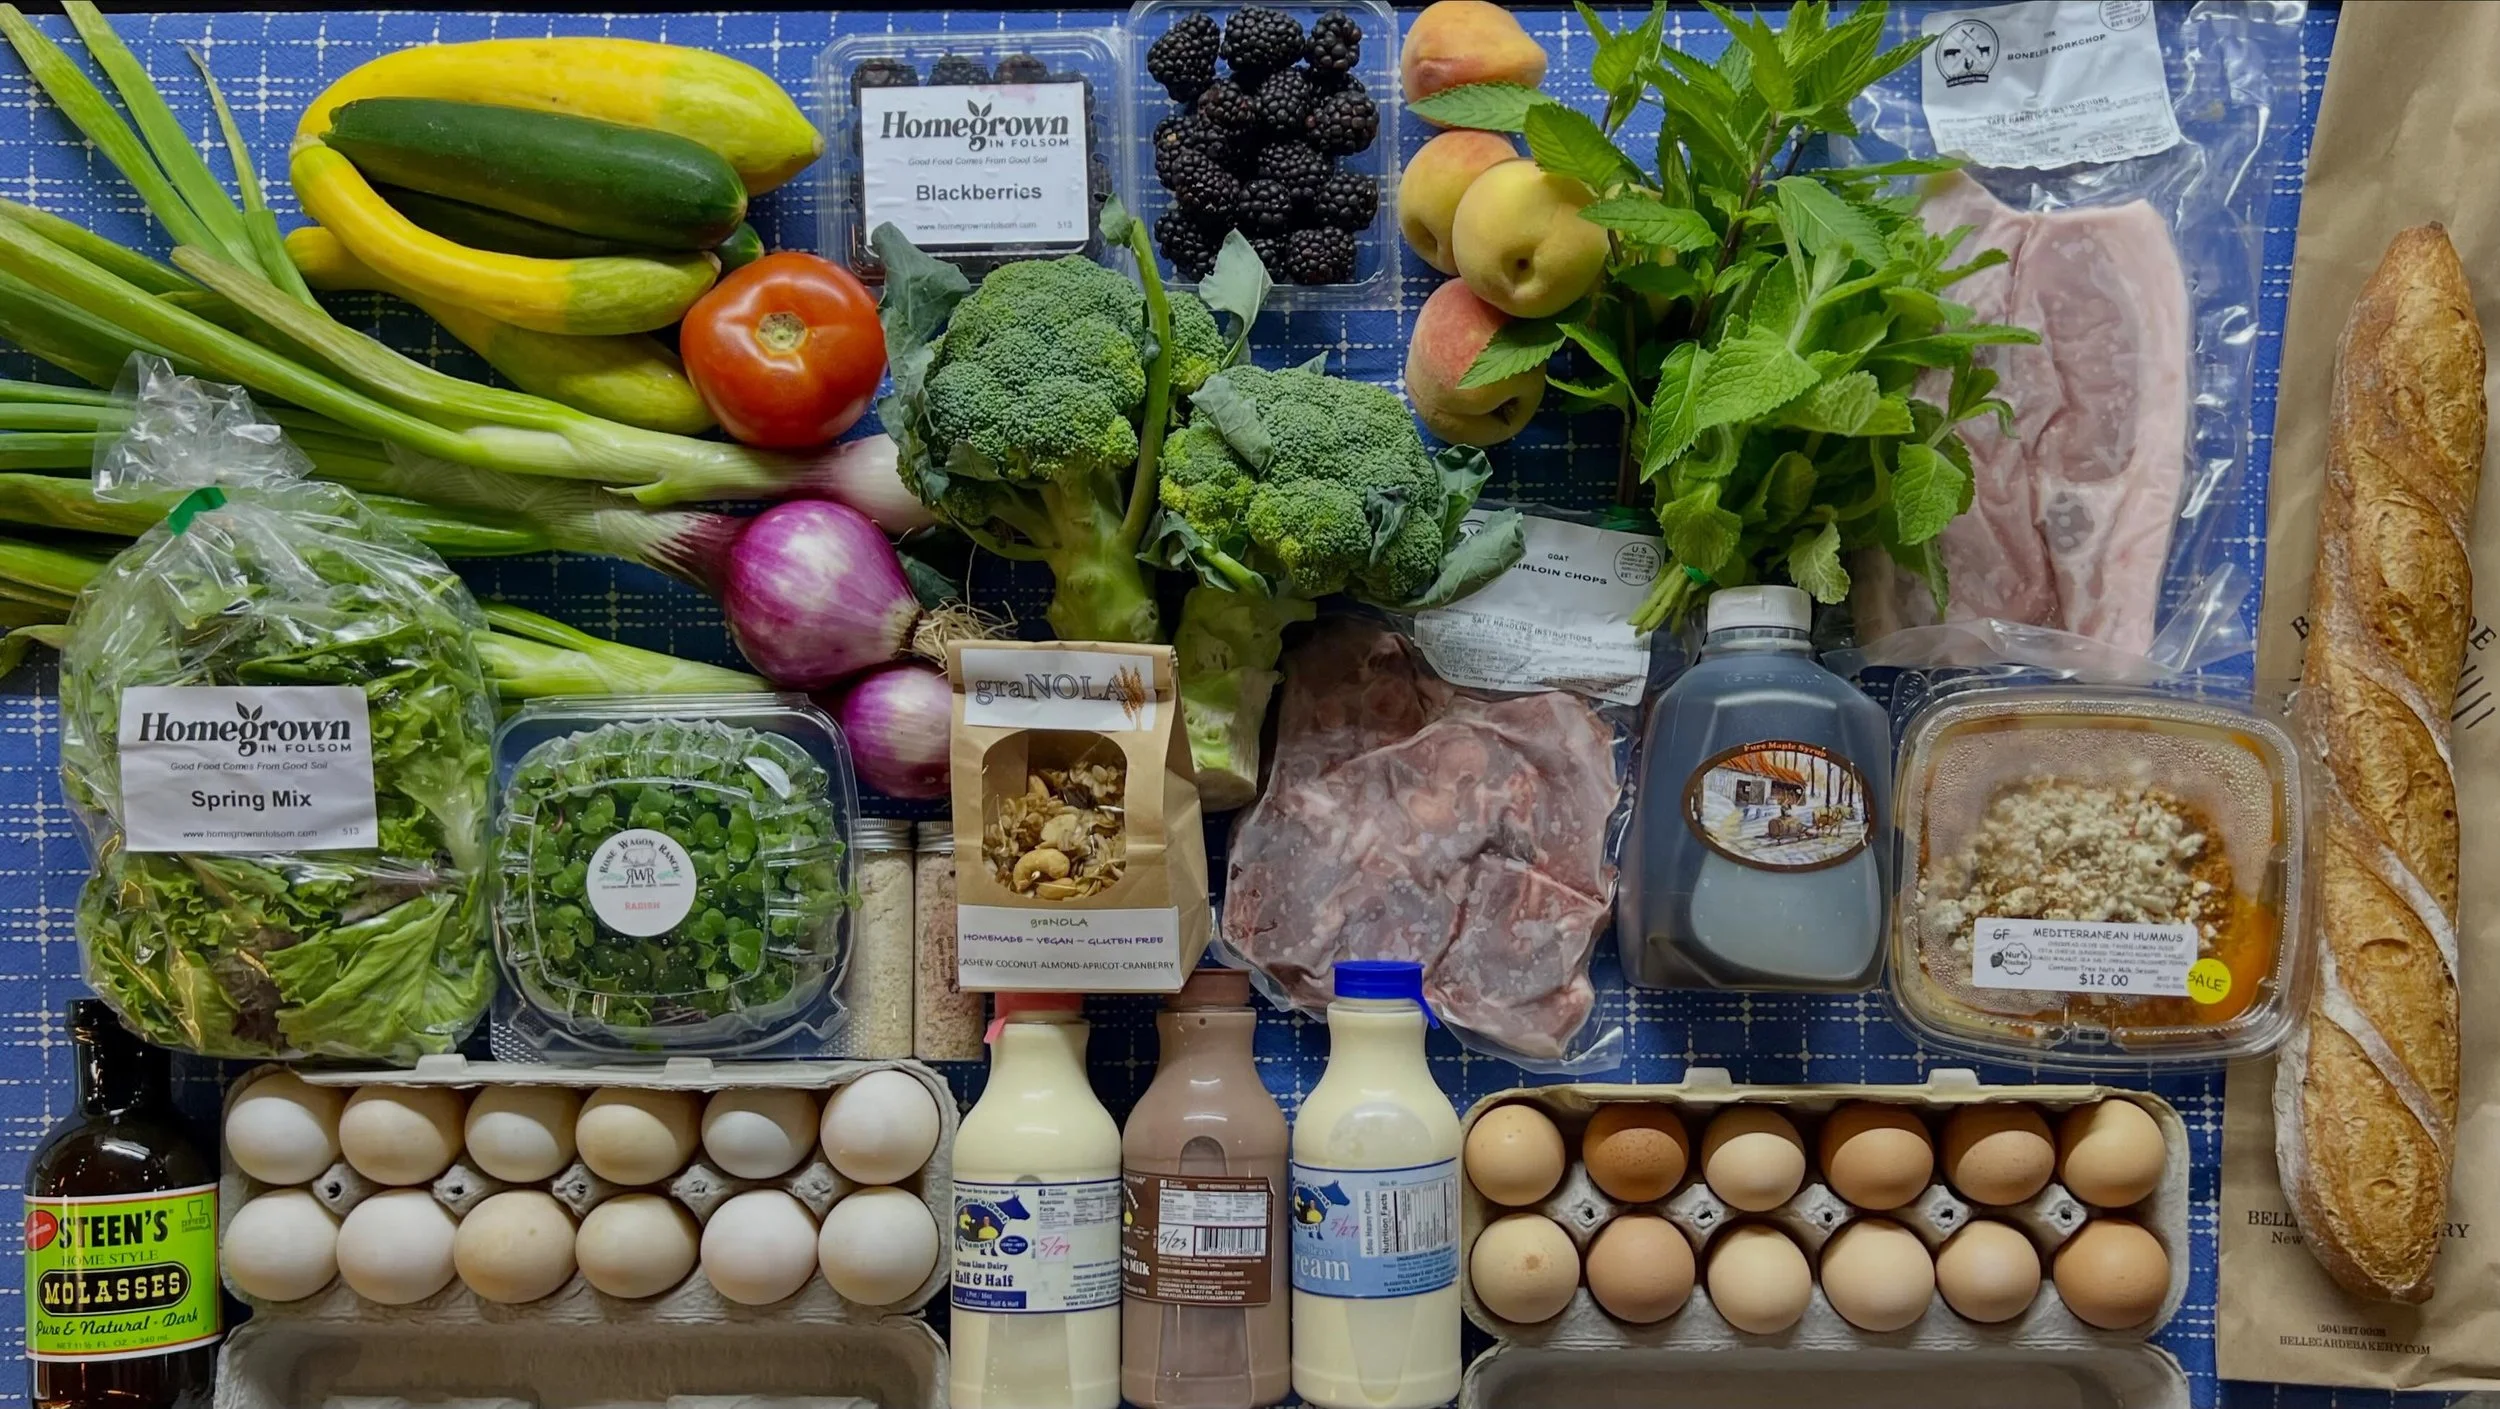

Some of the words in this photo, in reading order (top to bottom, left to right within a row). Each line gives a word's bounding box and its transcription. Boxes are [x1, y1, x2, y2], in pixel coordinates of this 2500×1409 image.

[2051, 34, 2105, 52] PORKCHOP
[880, 111, 1069, 151] Homegrown
[990, 139, 1003, 148] IN
[1012, 138, 1069, 147] FOLSOM
[908, 158, 930, 166] Good
[955, 157, 982, 165] Comes
[1009, 156, 1030, 164] Good
[916, 184, 1042, 200] Blackberries
[1548, 553, 1569, 562] GOAT
[1513, 562, 1560, 576] IRLOIN
[1565, 571, 1607, 584] CHOPS
[975, 674, 1128, 705] graNOLA
[139, 713, 351, 757] Homegrown
[261, 744, 276, 752] IN
[286, 743, 352, 752] FOLSOM
[1768, 742, 1796, 750] Maple
[1798, 744, 1827, 757] Syrup
[171, 762, 194, 770] Good
[197, 762, 220, 770] Food
[223, 762, 253, 770] Comes
[257, 762, 280, 770] From
[283, 762, 307, 770] Good
[311, 761, 328, 769] Soil
[191, 790, 264, 811] Spring
[273, 790, 312, 808] Mix
[343, 827, 359, 836] 513
[625, 901, 660, 910] RADISH
[1031, 918, 1088, 928] graNOLA
[964, 934, 1023, 943] HOMEMADE
[1036, 937, 1074, 946] VEGAN
[1088, 937, 1132, 945] GLUTEN
[1135, 936, 1163, 944] FREE
[1993, 928, 2011, 940] GF
[2033, 928, 2128, 941] MEDITERRANEAN
[2134, 931, 2184, 943] HUMMUS
[2005, 950, 2027, 959] Nur's
[2079, 973, 2128, 986] $12.00
[2188, 970, 2227, 992] SALE
[59, 1210, 168, 1248] STEEN'S
[1365, 1216, 1373, 1237] Heavy
[1381, 1217, 1390, 1254] Nutrition
[2272, 1231, 2304, 1244] New
[61, 1253, 104, 1266] HOME
[109, 1250, 158, 1265] STYLE
[987, 1262, 1008, 1271] Dairy
[1130, 1259, 1150, 1276] Milk
[1295, 1254, 1351, 1281] ream
[955, 1269, 971, 1284] Half
[973, 1273, 982, 1285] &
[985, 1274, 1014, 1287] Half
[44, 1272, 180, 1305] MOLASSES
[36, 1320, 60, 1336] Pure
[64, 1320, 75, 1335] &
[82, 1316, 150, 1335] Natural
[163, 1307, 198, 1326] Dark
[2280, 1336, 2430, 1354] BELLEGARDEBAKERY.COM
